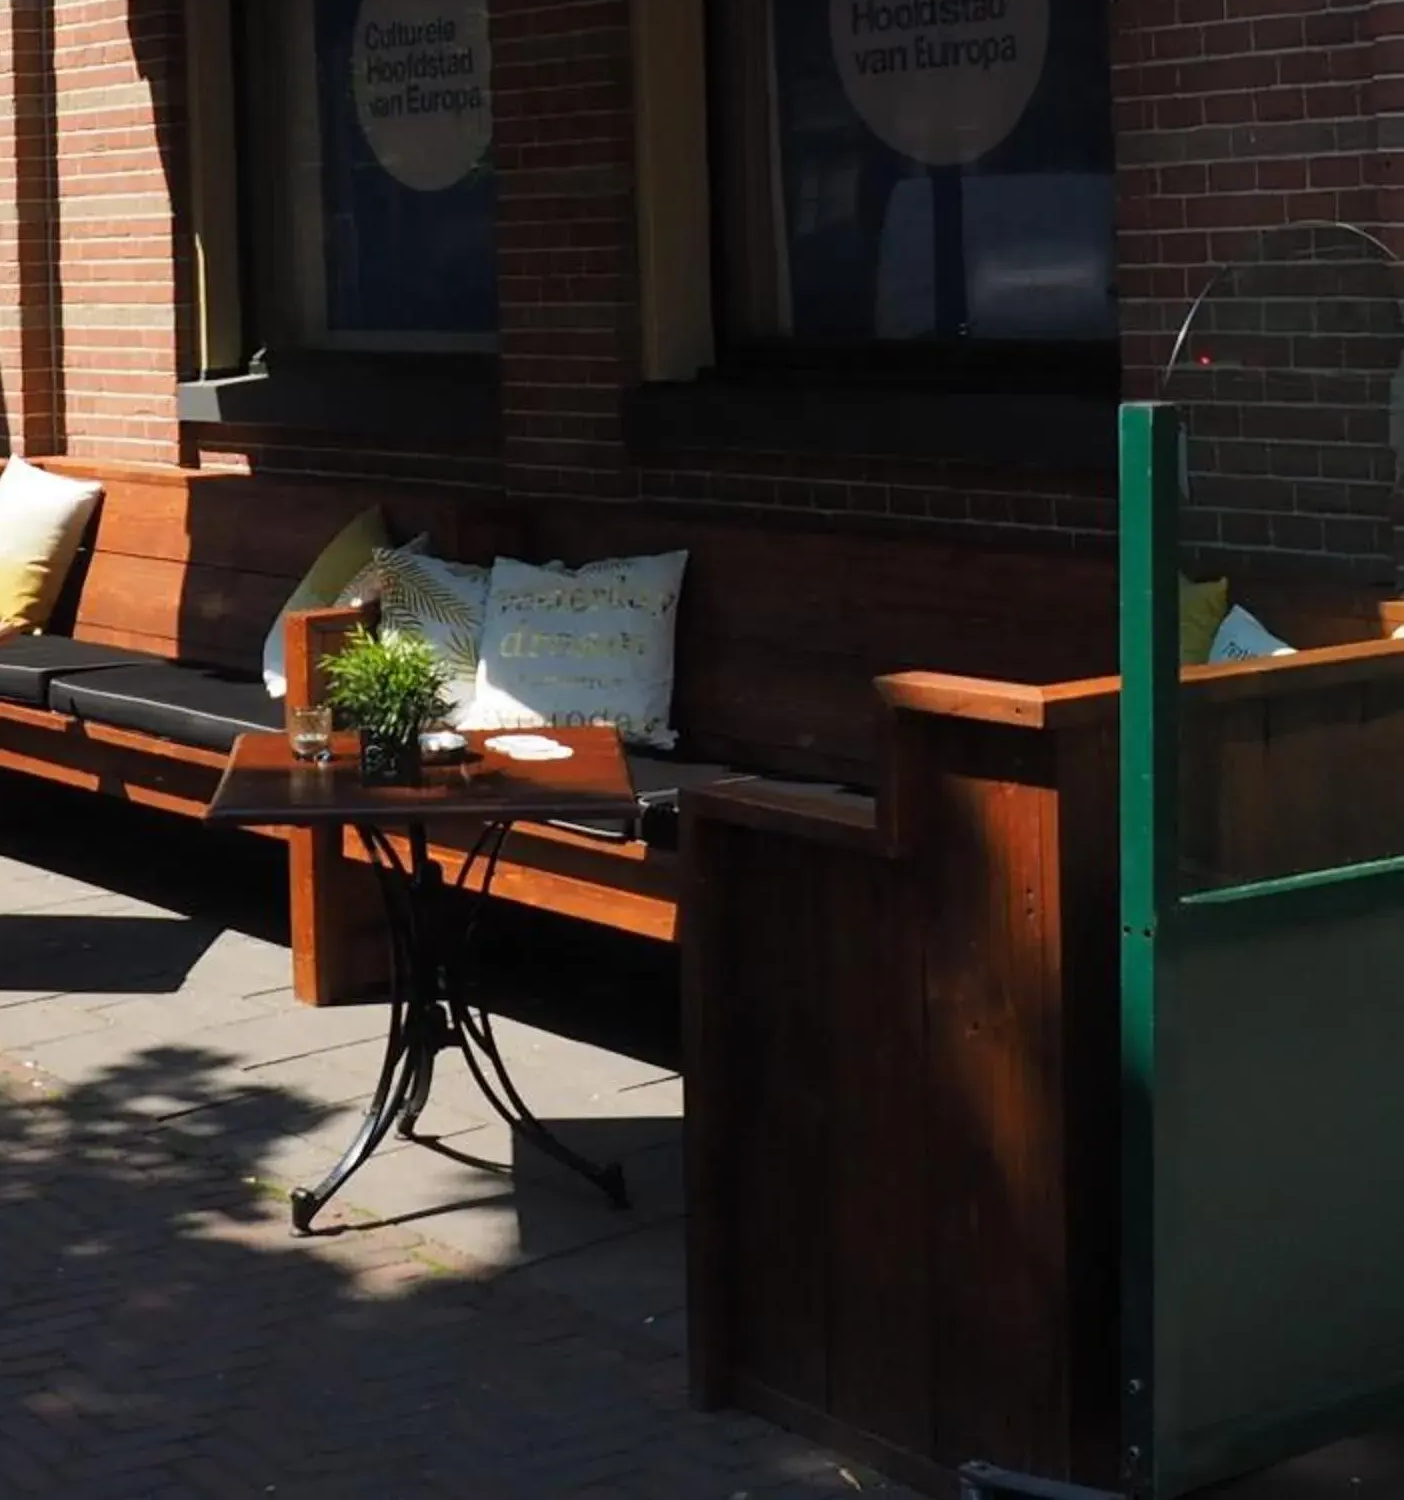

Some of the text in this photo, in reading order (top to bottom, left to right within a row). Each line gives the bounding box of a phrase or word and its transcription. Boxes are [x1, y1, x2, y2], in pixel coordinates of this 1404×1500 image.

[365, 16, 457, 51] Culturele
[366, 48, 474, 85] Hoofdstad
[854, 34, 1017, 76] van Europa
[370, 85, 483, 118] van Europa
